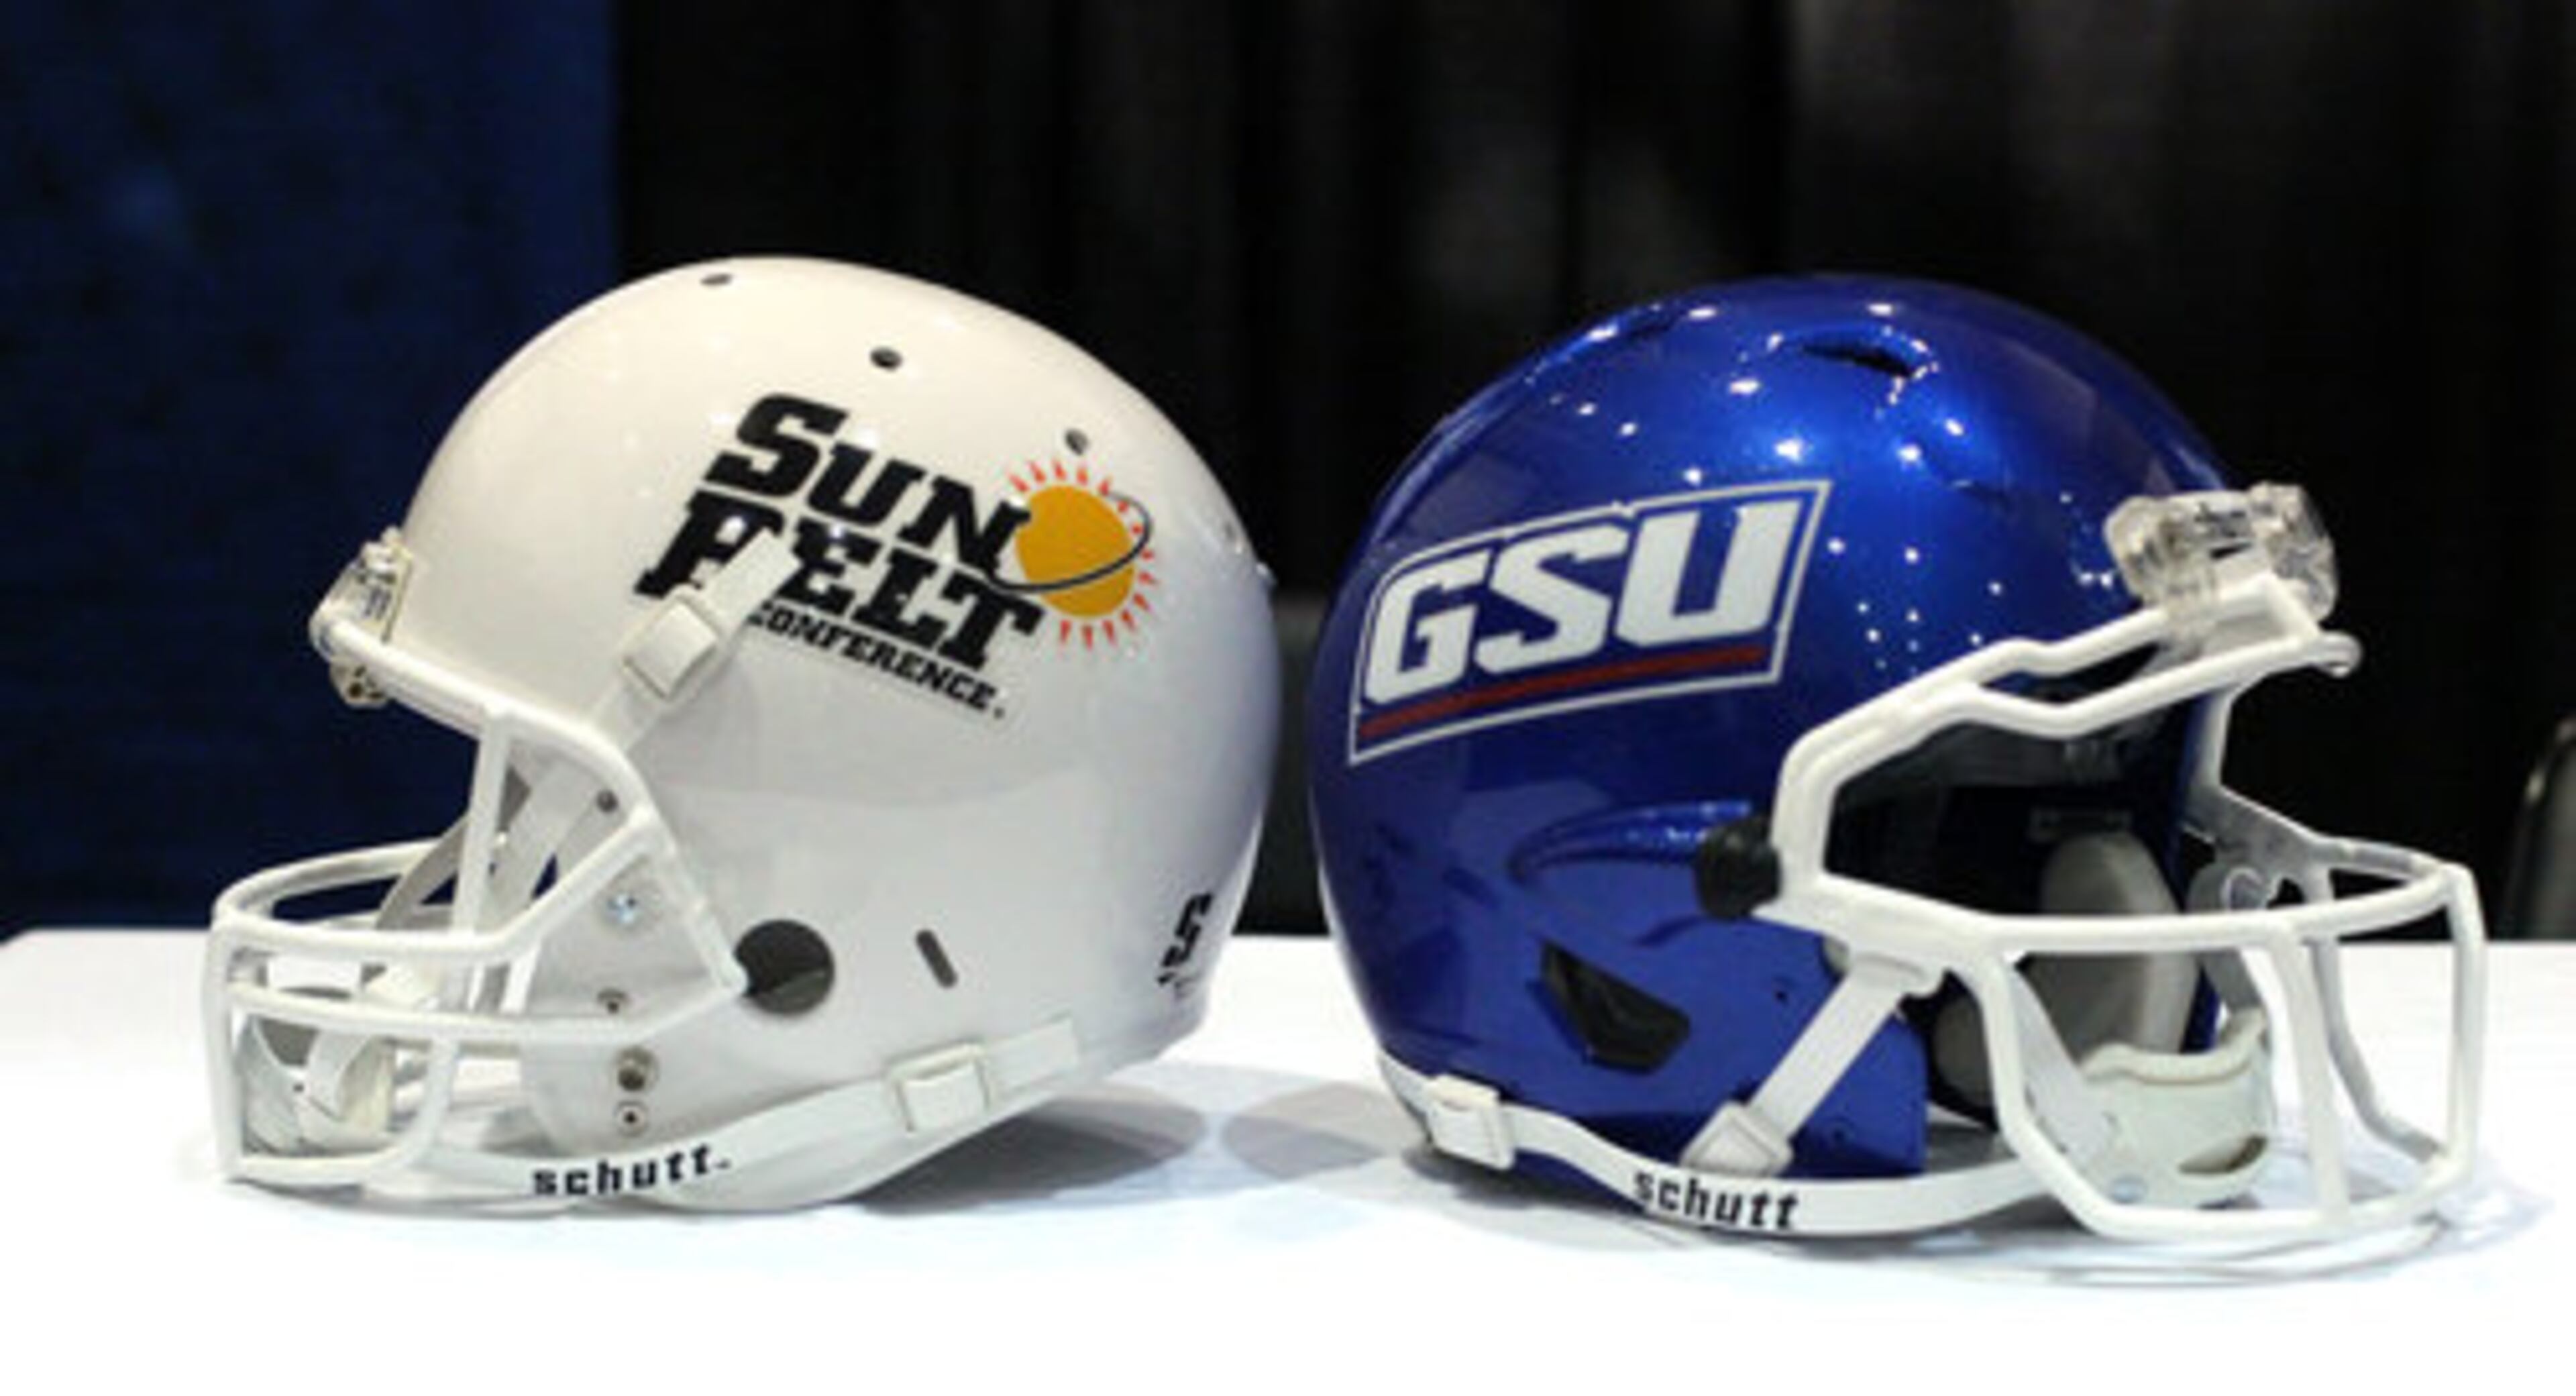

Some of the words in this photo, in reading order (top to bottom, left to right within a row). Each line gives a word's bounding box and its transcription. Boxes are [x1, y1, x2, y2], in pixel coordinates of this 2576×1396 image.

[703, 393, 1032, 576] SUN
[1364, 499, 1803, 704] GSU
[533, 1144, 711, 1195] schutt
[1634, 1171, 1799, 1229] schutt
